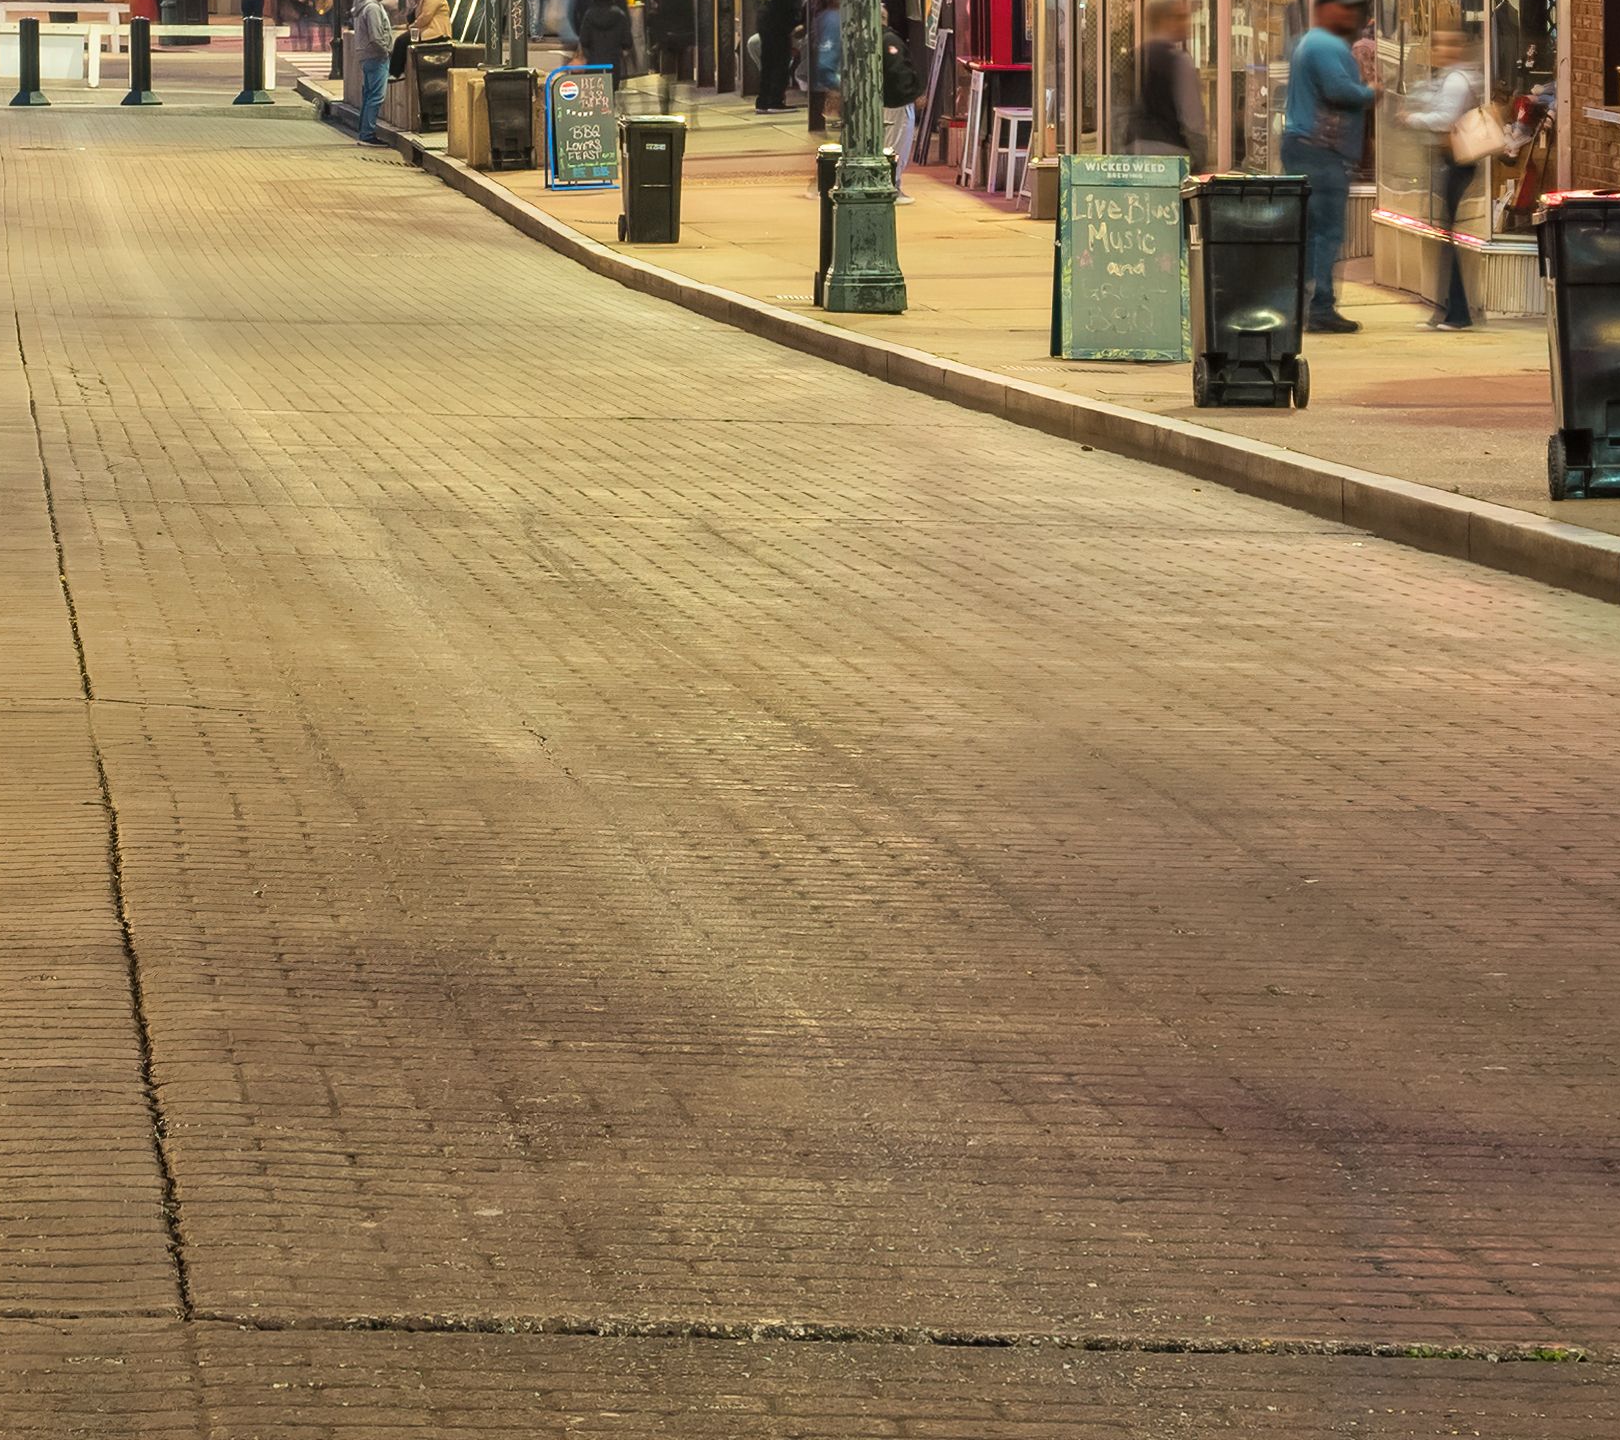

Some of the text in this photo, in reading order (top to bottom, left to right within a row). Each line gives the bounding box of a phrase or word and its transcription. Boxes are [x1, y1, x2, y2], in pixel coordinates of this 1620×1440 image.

[569, 124, 601, 139] BBQ
[565, 140, 603, 153] LOVERS
[568, 151, 601, 161] FEAST
[1085, 162, 1167, 173] WICKED WEED
[1072, 189, 1180, 225] Live Blues
[1088, 221, 1157, 255] Music
[1106, 259, 1146, 277] and
